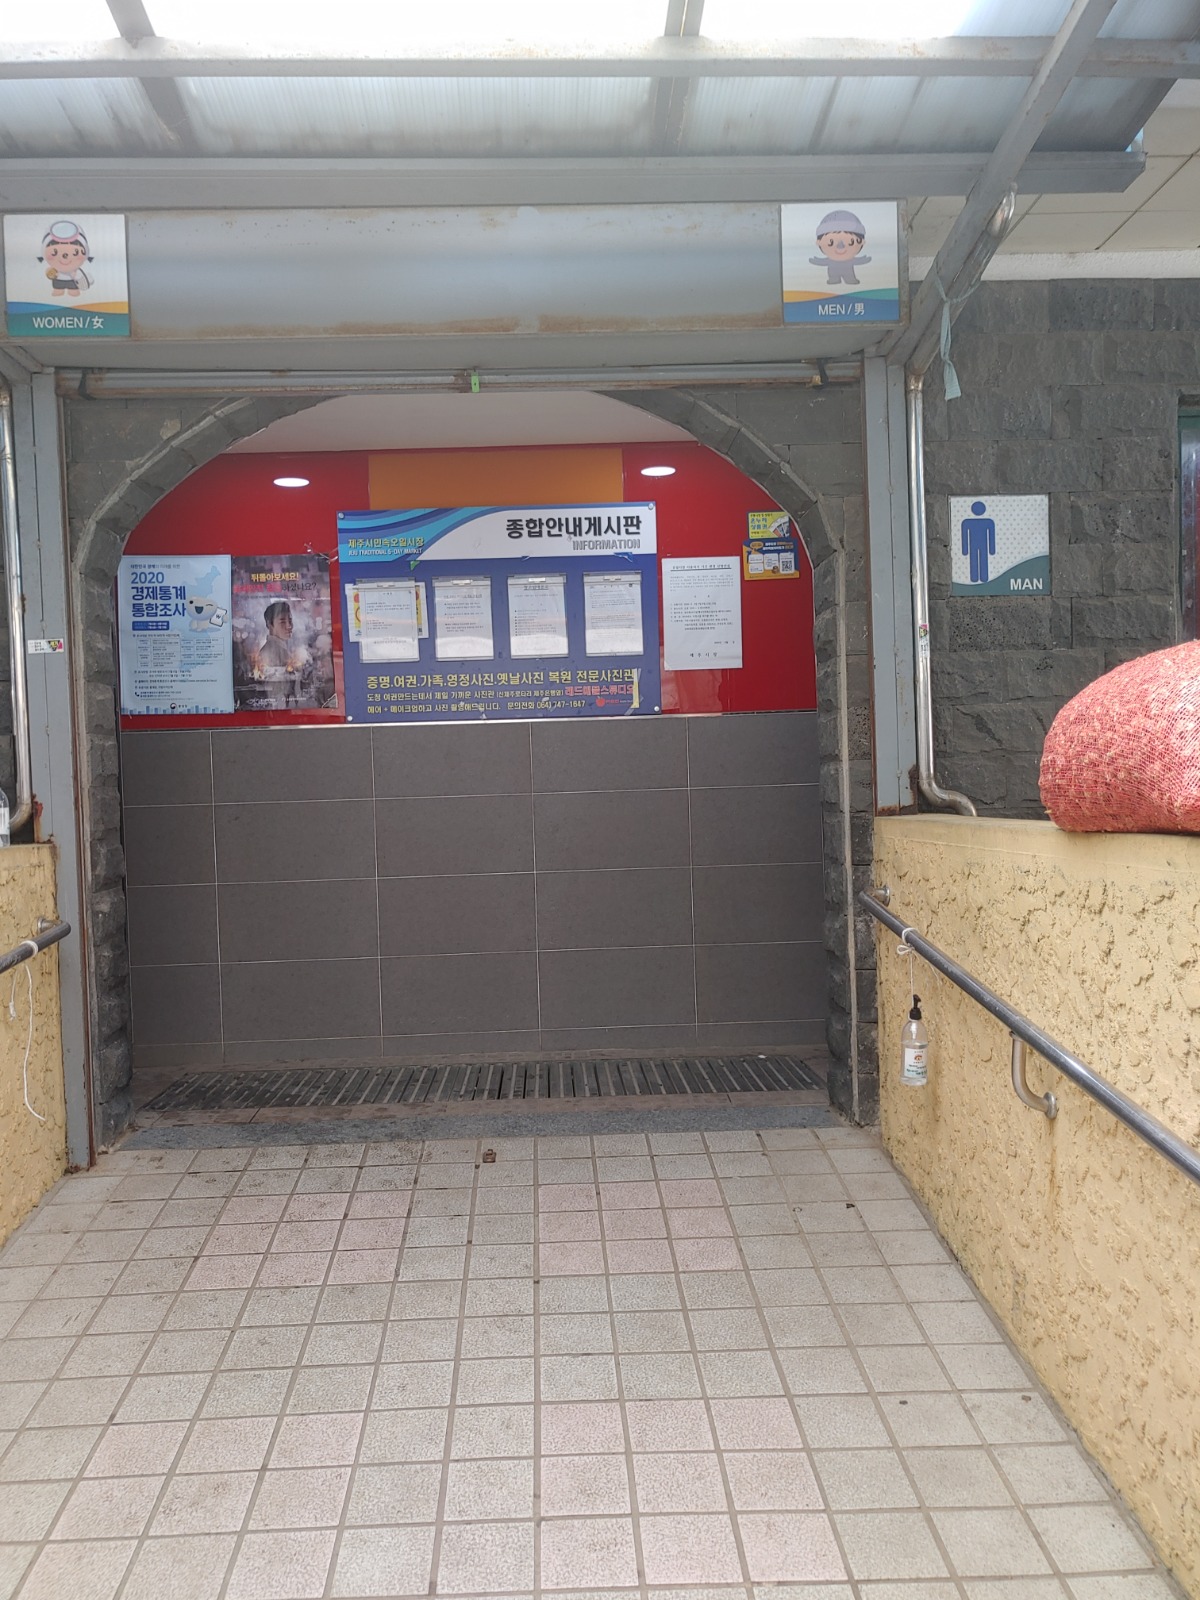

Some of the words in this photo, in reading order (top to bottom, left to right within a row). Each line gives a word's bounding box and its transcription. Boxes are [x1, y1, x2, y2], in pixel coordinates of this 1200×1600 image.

[506, 515, 642, 539] 종합안내게시판
[348, 537, 424, 548] 제주시민속오일시장
[572, 539, 641, 551] INFORMATION
[131, 572, 165, 585] 2020
[251, 572, 299, 582] 뒤돌아보세요!
[1010, 578, 1043, 591] MAN
[131, 585, 187, 601] 경제통계
[131, 602, 187, 618] 통합조사
[548, 671, 572, 683] 복원
[576, 668, 635, 683] 전문사진관
[367, 693, 381, 702] 도청
[383, 692, 432, 702] 여권만드는데서
[434, 691, 449, 700] 제일
[451, 691, 472, 699] 가까운
[474, 690, 495, 699] 사진관
[367, 706, 382, 714] 헤어
[390, 704, 432, 713] 메이크업하고
[434, 704, 449, 712] 사진
[507, 701, 535, 710] 문의전화
